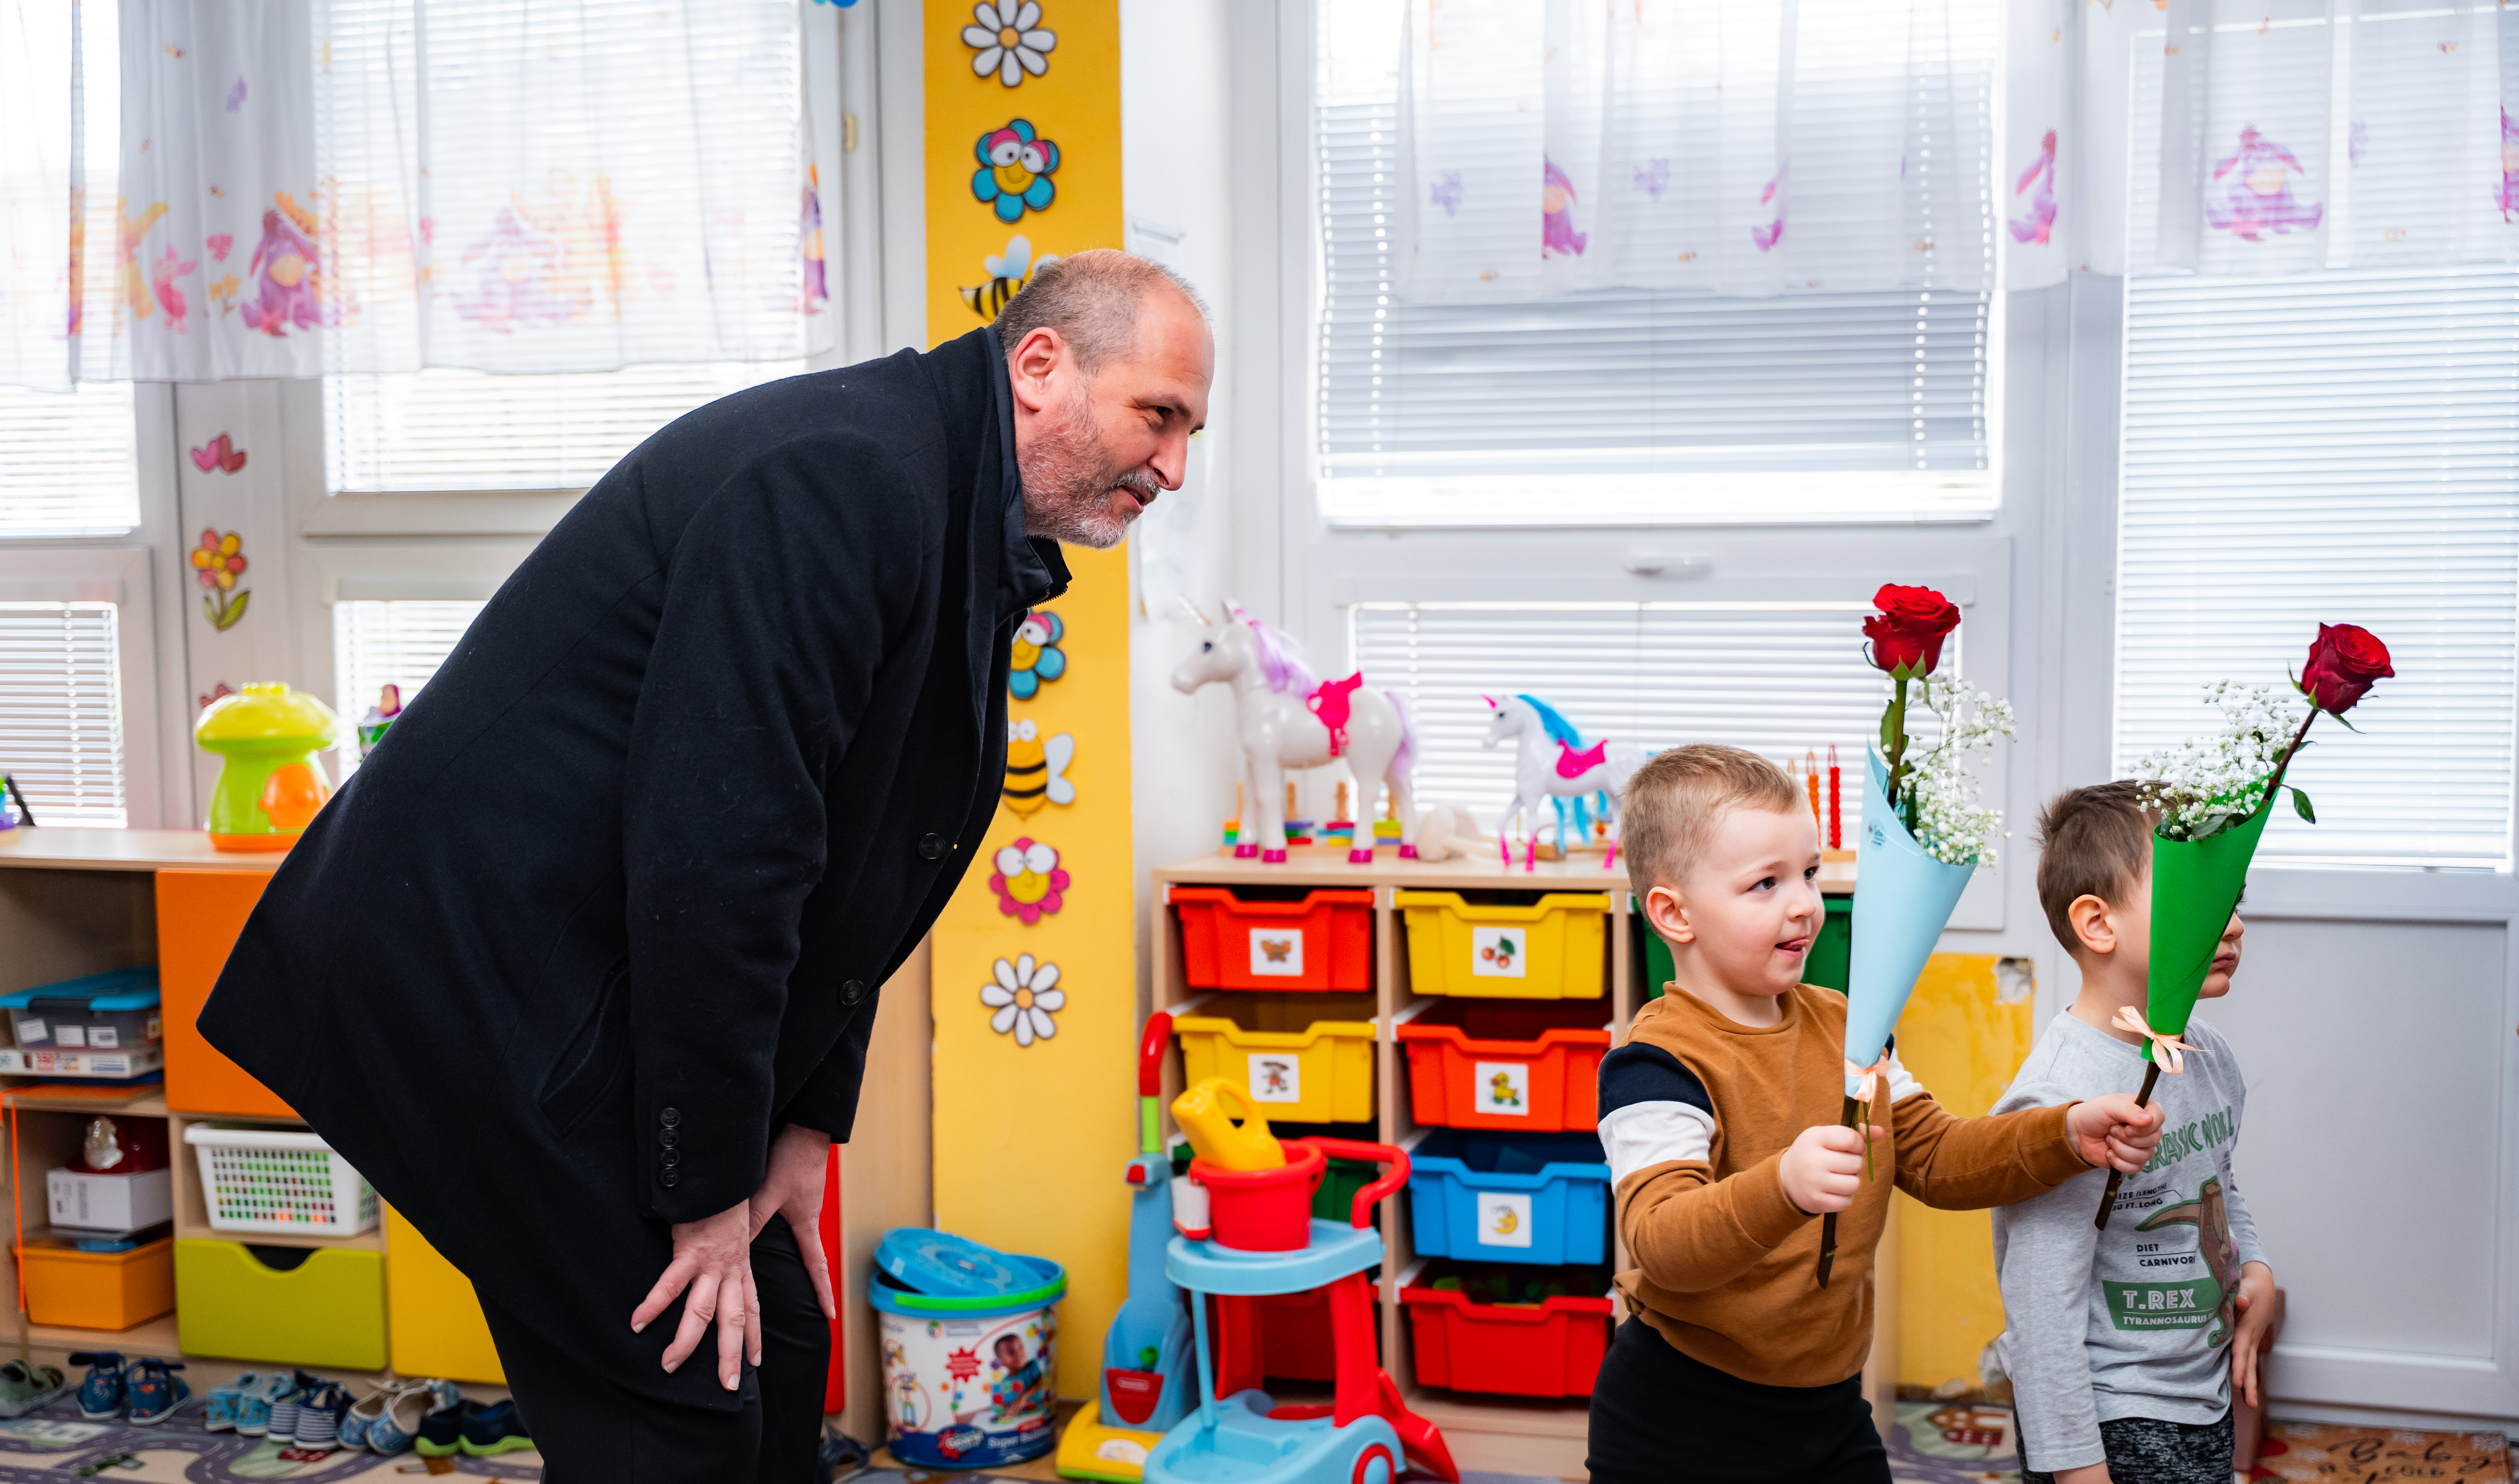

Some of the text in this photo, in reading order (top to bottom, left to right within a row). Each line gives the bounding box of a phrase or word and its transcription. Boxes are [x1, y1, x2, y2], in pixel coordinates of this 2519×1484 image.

[2116, 1182, 2166, 1200] IZE (LENGTH)
[2137, 1243, 2159, 1252] DIET
[2123, 1288, 2196, 1310] T.REX
[2123, 1315, 2207, 1325] TYRANNOSAURUS
